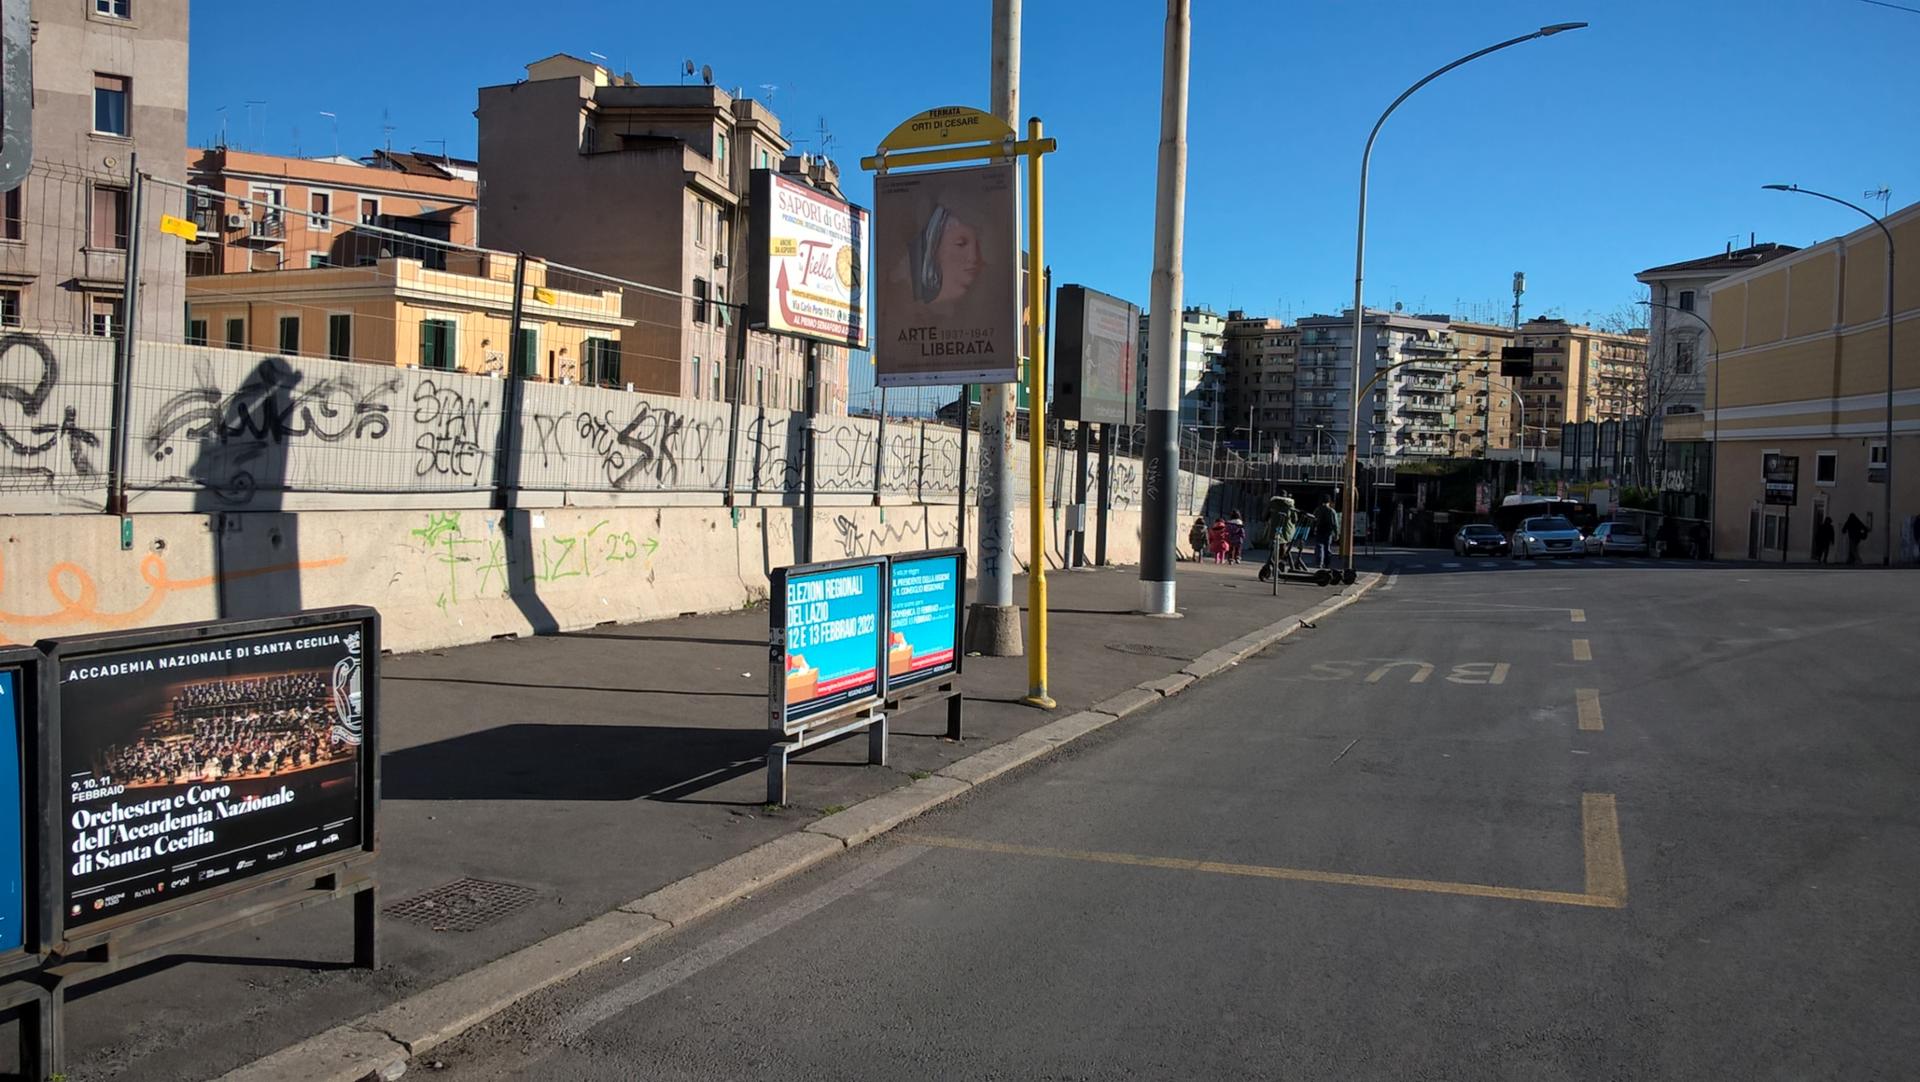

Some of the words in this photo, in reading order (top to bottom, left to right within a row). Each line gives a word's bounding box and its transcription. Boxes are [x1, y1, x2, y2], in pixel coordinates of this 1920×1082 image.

[912, 122, 932, 132] ORTI
[934, 121, 942, 129] DI
[945, 116, 979, 128] CESARE
[929, 107, 960, 119] FERMATA
[779, 191, 822, 223] SAPORI
[823, 209, 832, 227] di
[799, 240, 834, 286] Tiella
[898, 327, 938, 342] ARTE
[921, 340, 995, 357] LIBERATA
[788, 580, 824, 605] ELEZIONI
[825, 575, 863, 600] REGIONALI
[788, 605, 804, 627] DEL
[805, 601, 829, 624] LAZIO
[788, 627, 799, 649] 12
[801, 626, 806, 647] E
[809, 624, 820, 645] 13
[821, 617, 857, 644] FEBBRAIO
[857, 613, 875, 635] 2023
[69, 660, 155, 681] ACCADEMIA
[159, 648, 232, 669] NAZIONALE
[236, 647, 249, 658] DI
[254, 641, 292, 656] SANTA
[296, 634, 340, 650] CECILIA
[1301, 661, 1511, 684] BUS
[71, 785, 125, 803] FEBBRAIO
[100, 776, 111, 786] 11
[72, 798, 171, 830] Orchestra
[174, 795, 185, 808] e
[187, 785, 231, 805] Coro
[215, 785, 295, 821] Nazionale
[72, 855, 93, 876] di
[95, 844, 152, 871] Santa
[154, 828, 215, 856] Cecilia
[134, 887, 155, 899] ROMA
